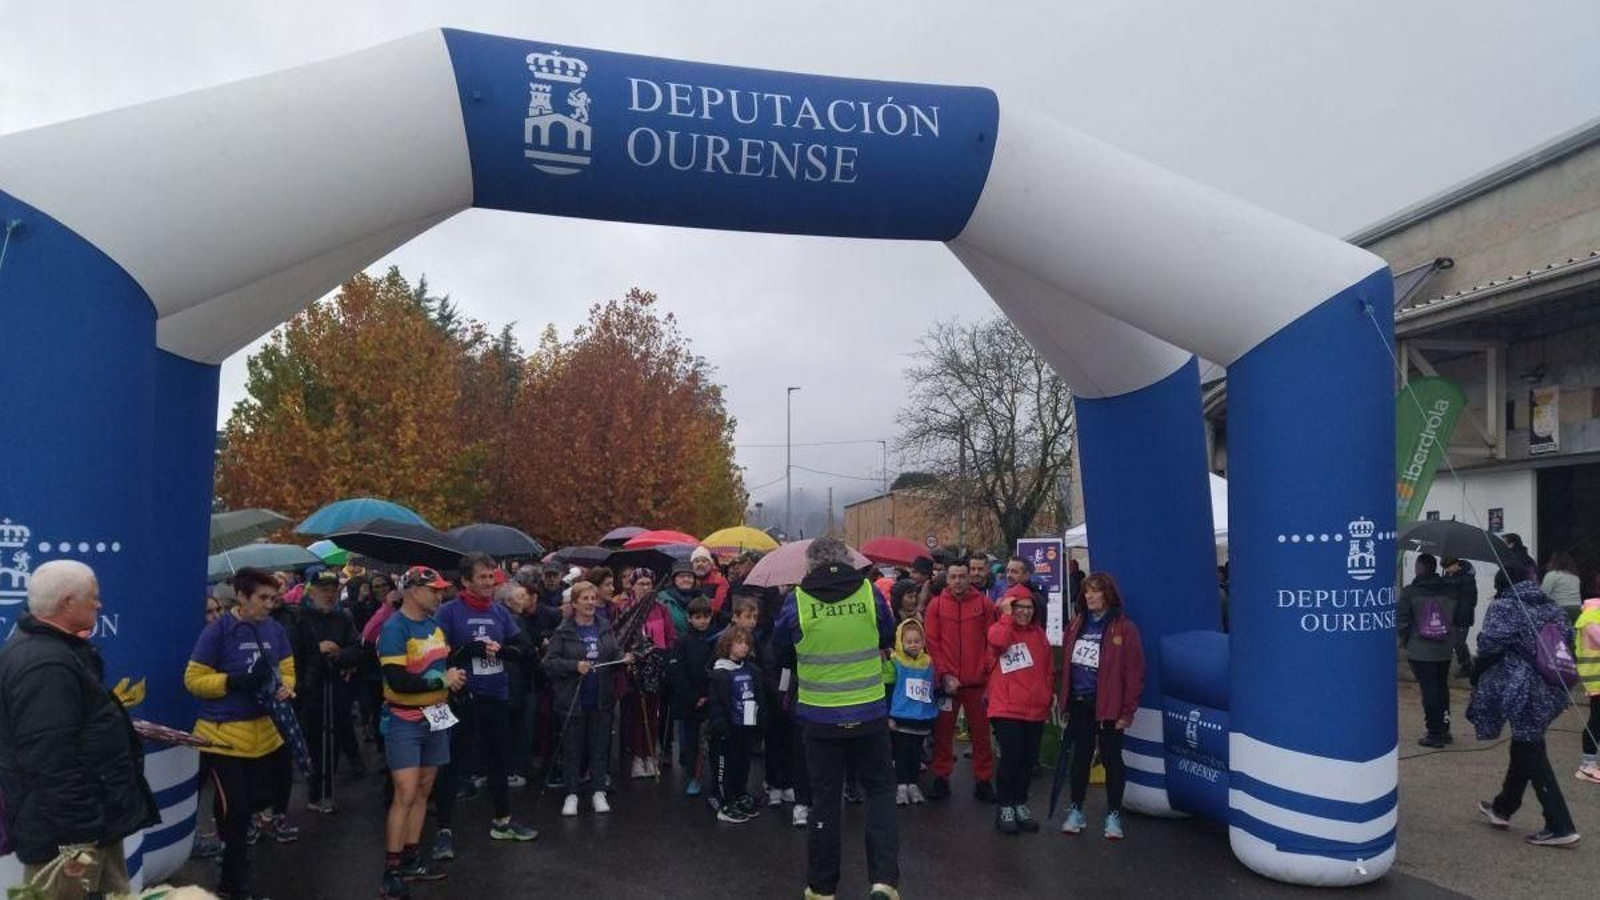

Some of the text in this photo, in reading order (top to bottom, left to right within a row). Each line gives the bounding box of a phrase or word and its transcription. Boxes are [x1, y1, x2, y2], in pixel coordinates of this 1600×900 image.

[626, 76, 940, 138] DEPUTACIÓN
[626, 126, 859, 184] OURENSE
[810, 601, 867, 619] Parra
[1300, 610, 1397, 632] OURENSE
[1075, 646, 1098, 661] 472
